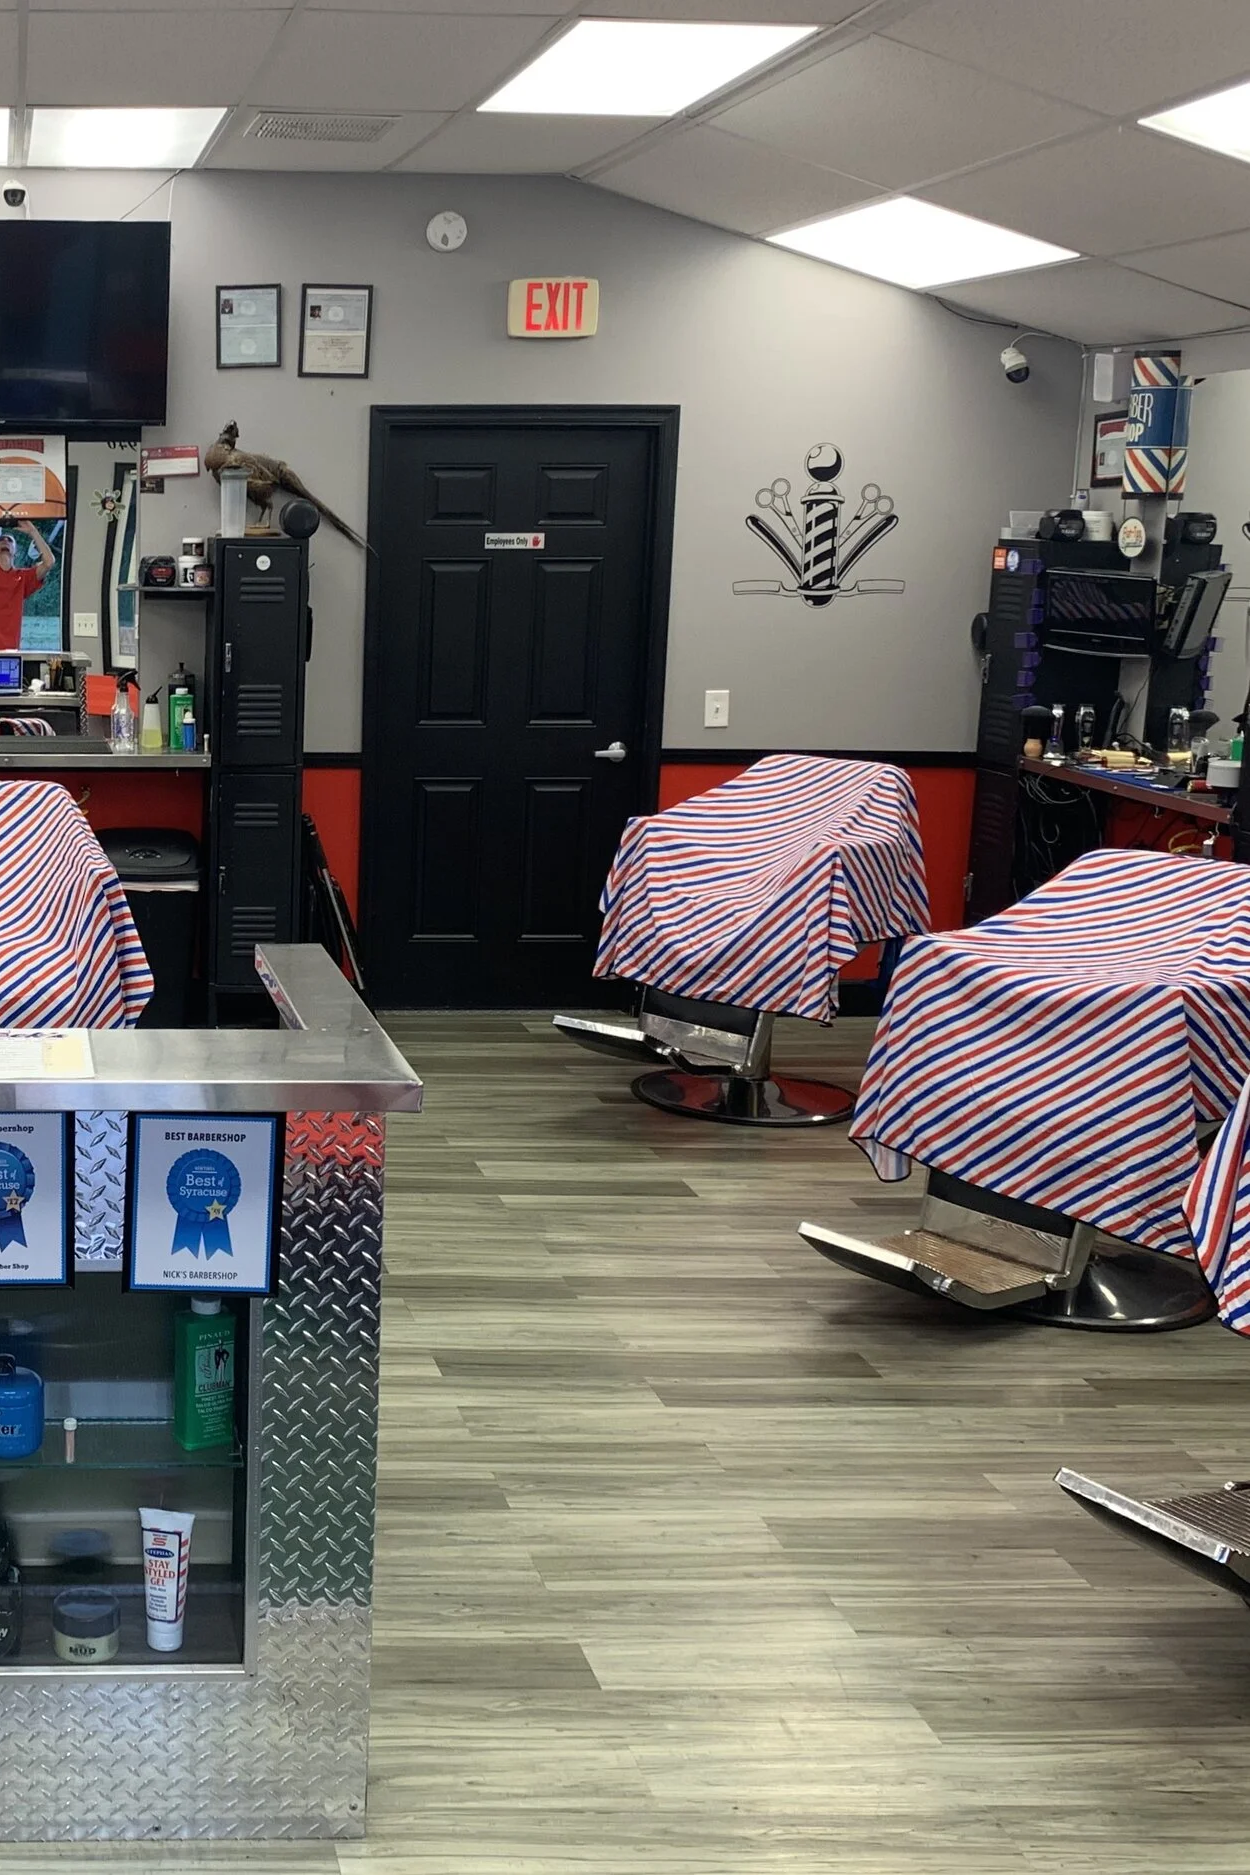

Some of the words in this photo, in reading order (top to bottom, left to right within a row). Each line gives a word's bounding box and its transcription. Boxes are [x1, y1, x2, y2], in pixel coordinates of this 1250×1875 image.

[525, 282, 588, 331] EXIT
[1128, 393, 1154, 428] BER
[486, 537, 515, 547] Employees
[516, 537, 528, 547] Only
[165, 1132, 186, 1141] BEST
[187, 1133, 247, 1143] BARBERSHOP
[9, 1169, 17, 1181] of
[186, 1173, 216, 1187] Best
[217, 1177, 225, 1187] of
[179, 1187, 228, 1198] Syracuse
[12, 1263, 29, 1271] Shop
[163, 1270, 187, 1279] NICK'S
[189, 1271, 238, 1280] BARBERSHOP
[199, 1330, 230, 1340] PINAUD
[198, 1380, 230, 1392] CLUBMAN
[146, 1549, 174, 1557] STEPHAN
[149, 1560, 170, 1569] STAY
[144, 1568, 175, 1578] STYLED
[150, 1578, 166, 1586] GEL
[69, 1647, 96, 1655] MUD
